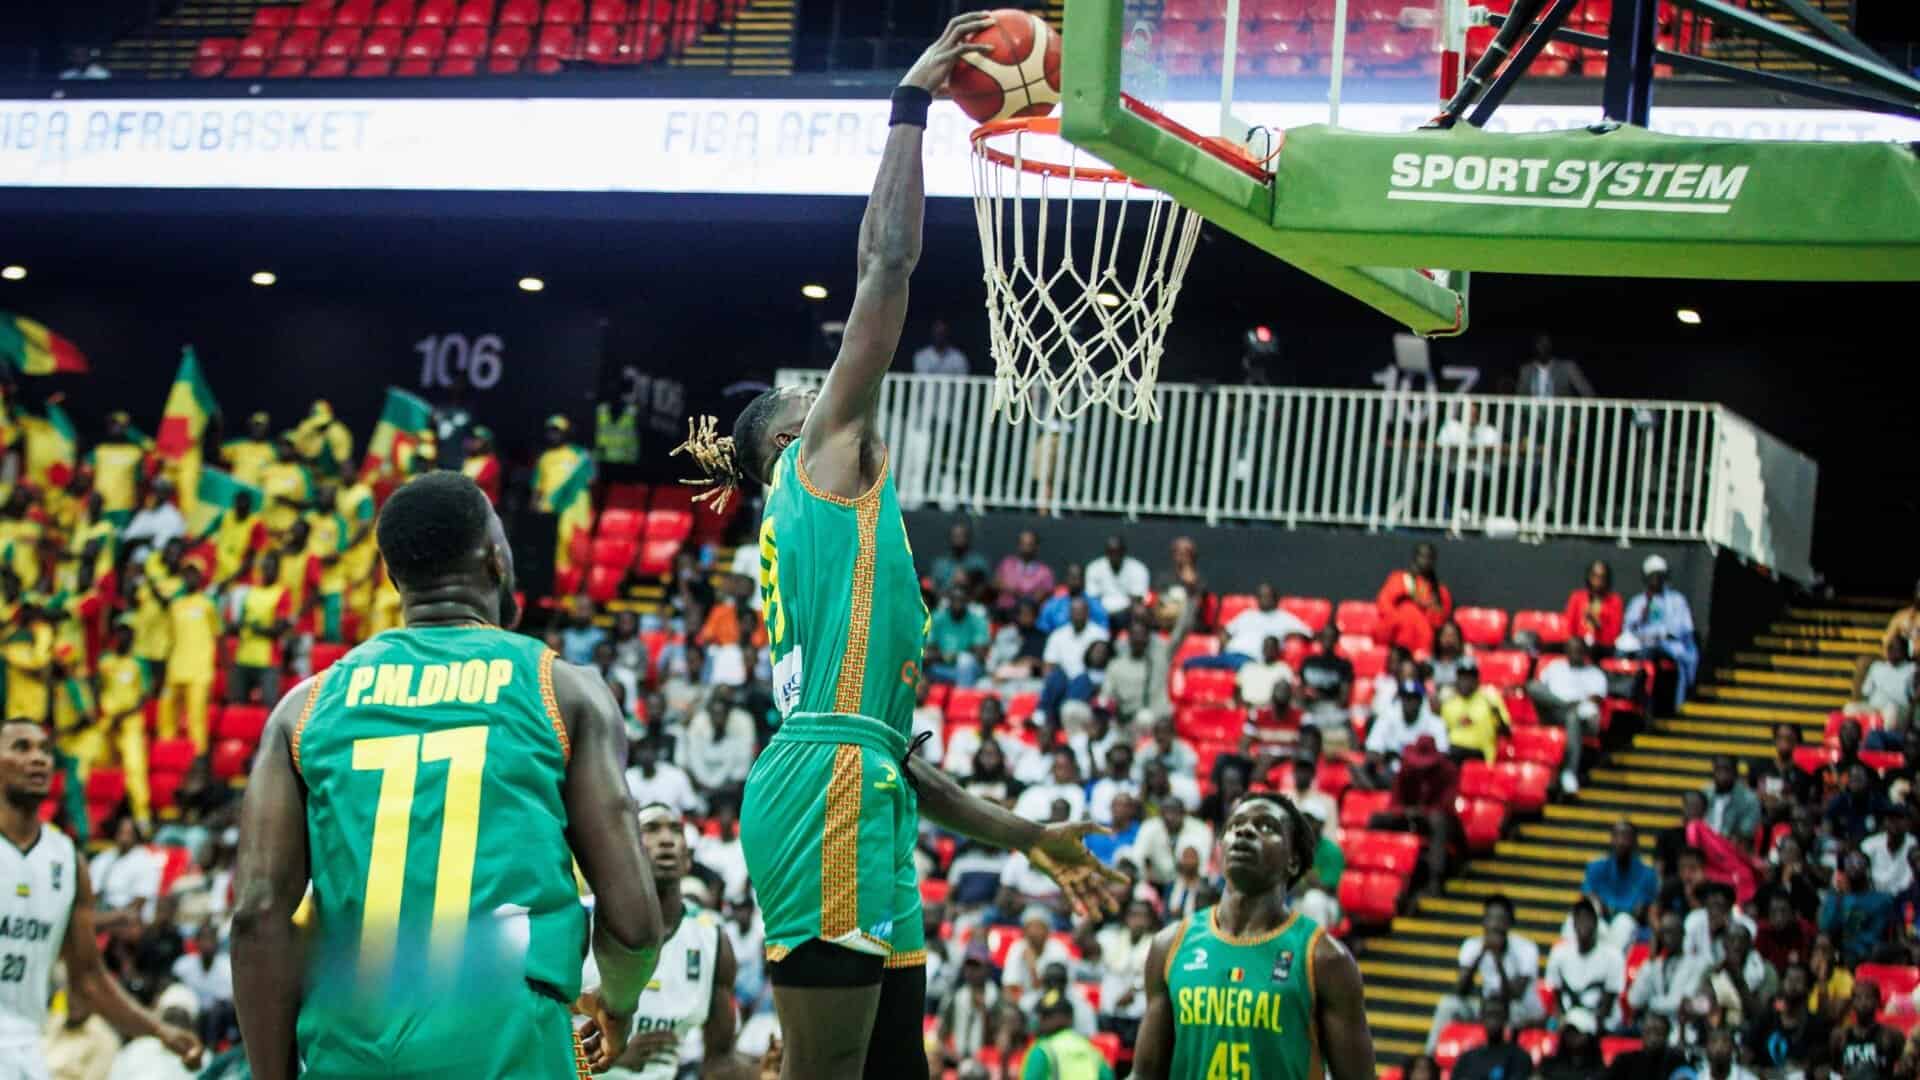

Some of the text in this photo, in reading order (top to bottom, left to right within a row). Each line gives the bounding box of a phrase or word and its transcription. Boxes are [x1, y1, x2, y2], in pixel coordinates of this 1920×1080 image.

[0, 111, 372, 151] IBA AFROBASKET
[663, 112, 762, 153] FIBA
[414, 334, 504, 388] 106
[345, 658, 513, 708] P.M.DIOP
[0, 915, 52, 942] ABON
[1178, 986, 1282, 1033] SENEGAL
[1206, 1042, 1251, 1080] 45
